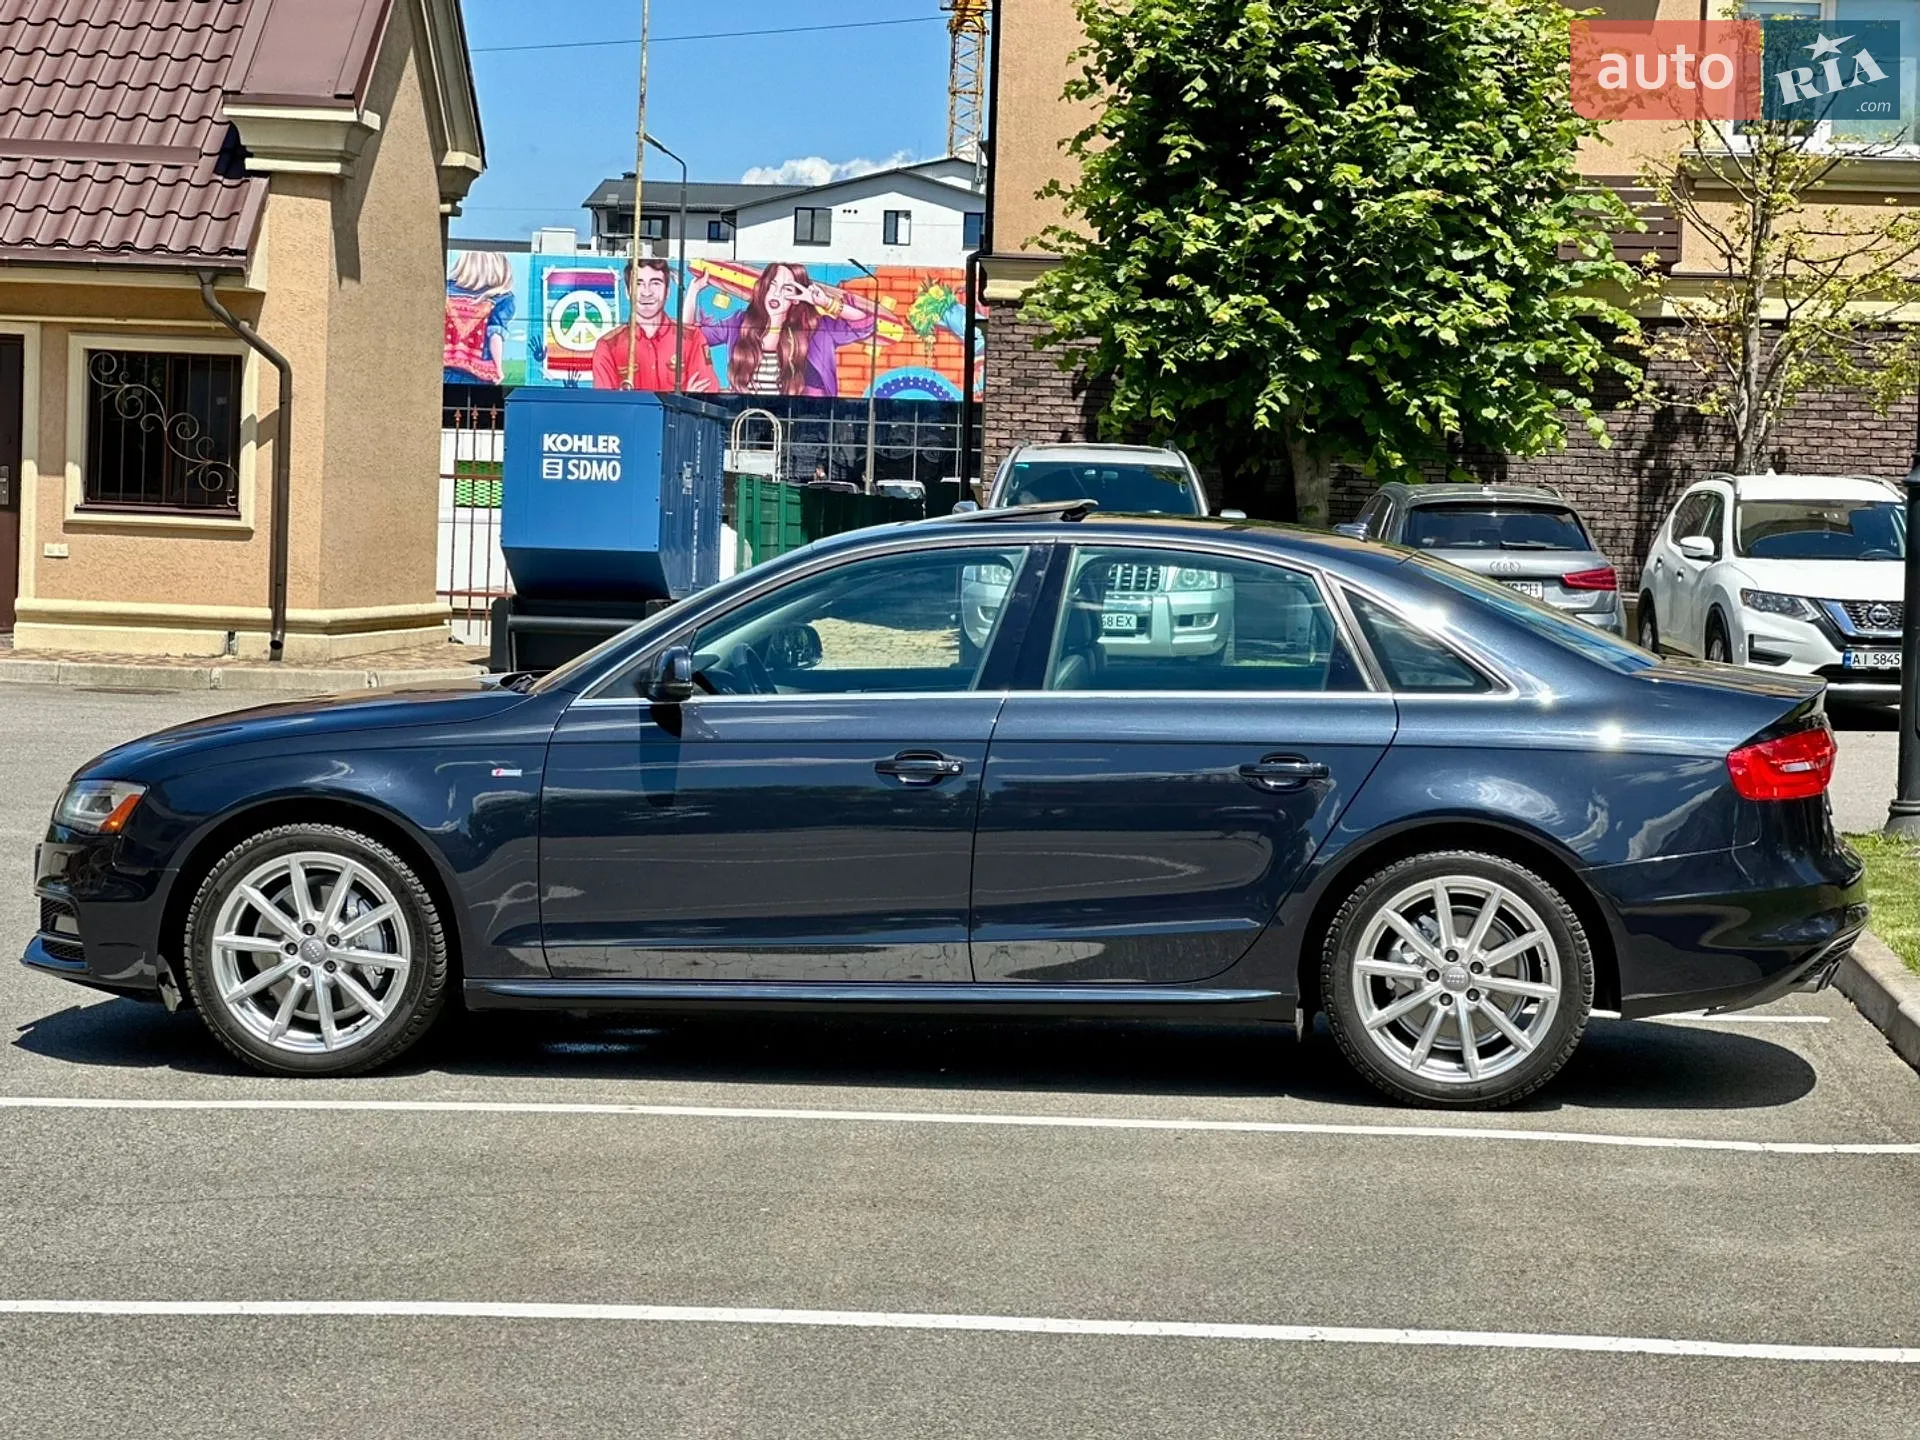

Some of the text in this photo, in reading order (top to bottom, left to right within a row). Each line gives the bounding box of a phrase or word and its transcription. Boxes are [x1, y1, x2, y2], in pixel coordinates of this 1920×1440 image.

[542, 433, 621, 454] KOHLER
[567, 459, 622, 482] SDMO
[1116, 615, 1132, 627] EX
[1873, 653, 1901, 665] 5845
